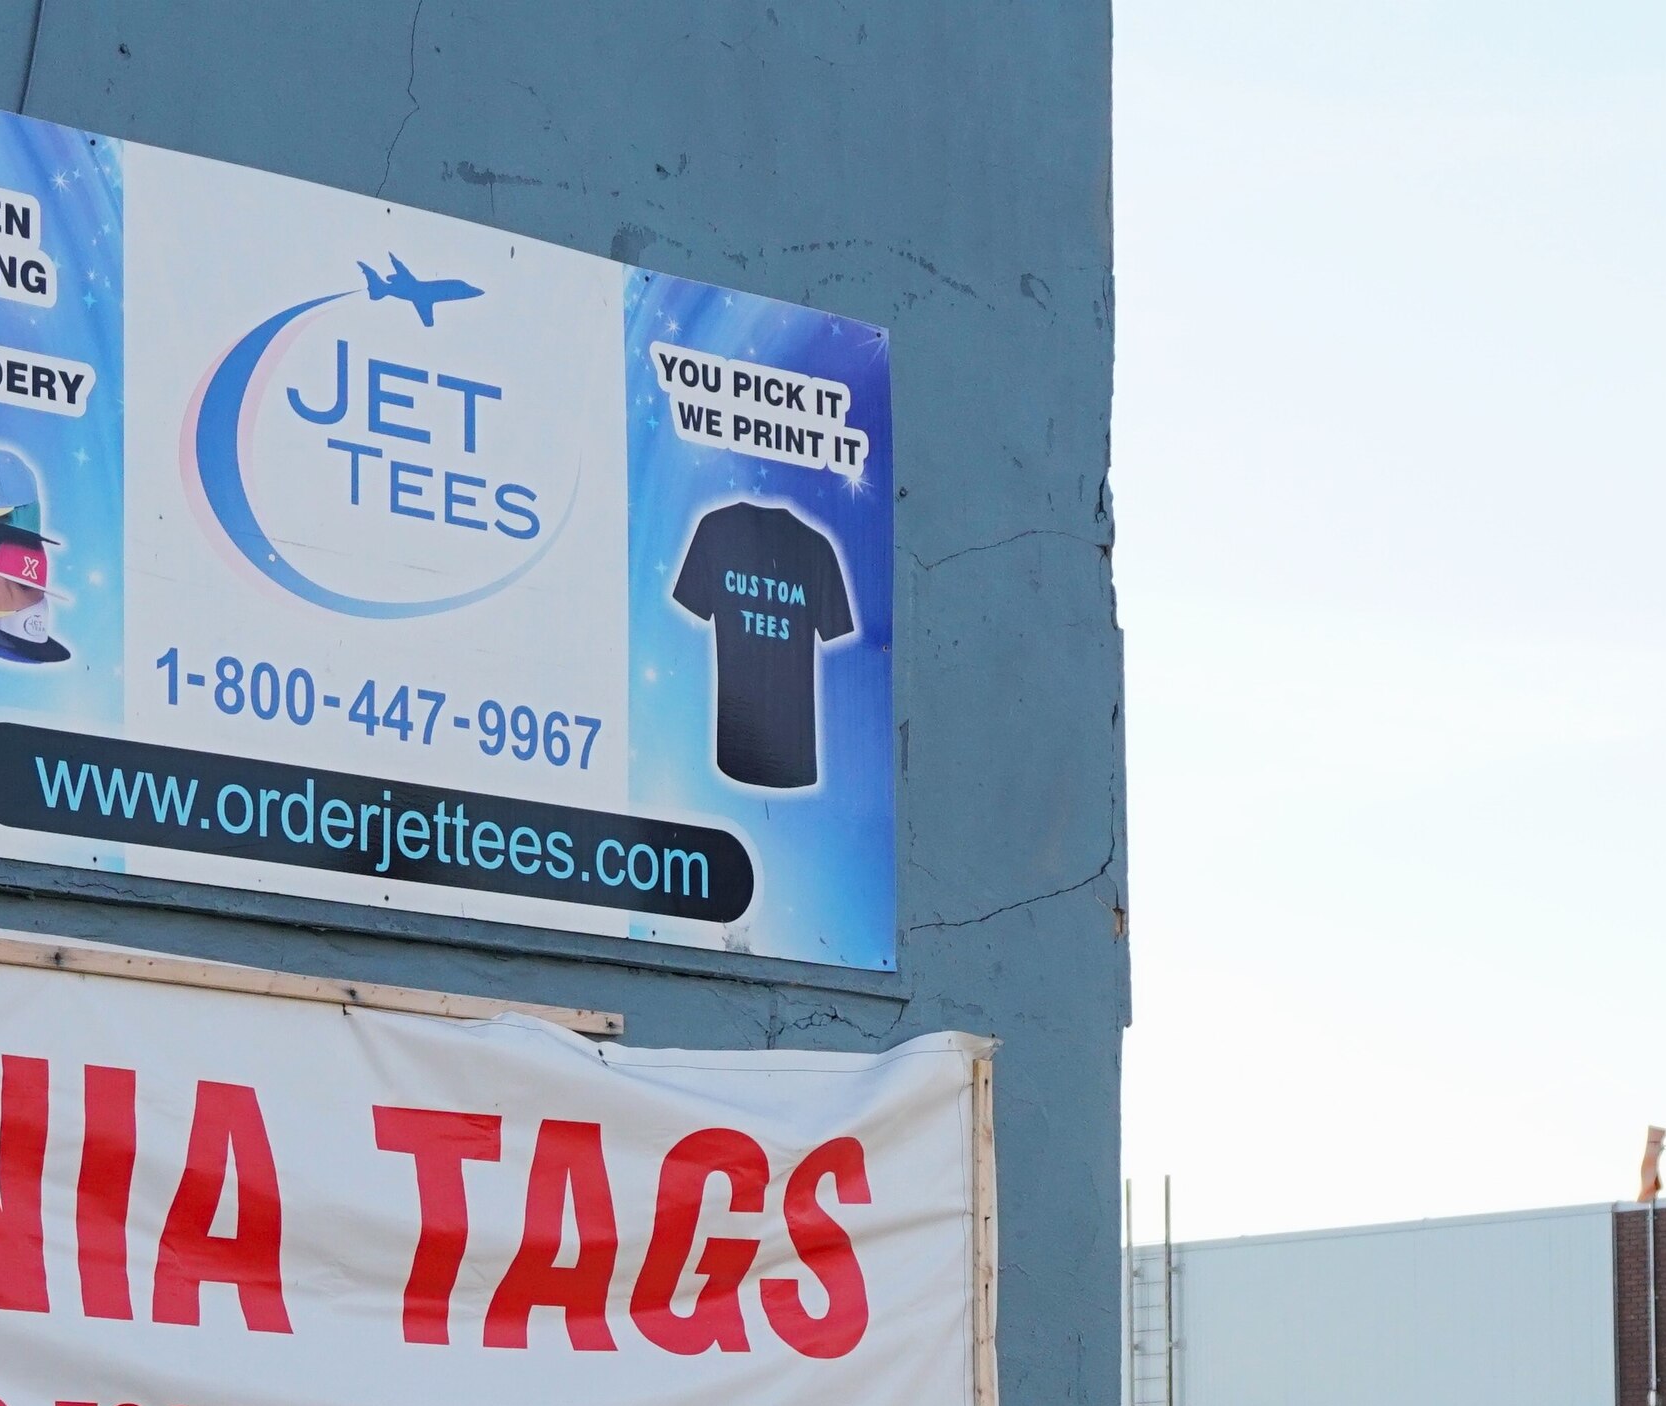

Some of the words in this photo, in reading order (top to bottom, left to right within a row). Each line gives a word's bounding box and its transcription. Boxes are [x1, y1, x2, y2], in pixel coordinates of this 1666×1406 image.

[286, 339, 502, 453] JET
[658, 353, 722, 393] YOU
[733, 370, 806, 412] PICK
[816, 388, 843, 419] IT
[678, 401, 723, 438] WE
[733, 414, 825, 459] PRINT
[835, 435, 861, 466] IT
[327, 437, 541, 540] TEES
[21, 556, 39, 580] X
[724, 569, 807, 607] CUSTOM
[740, 609, 790, 640] TEES
[156, 647, 602, 770] 1-800-447-9967
[35, 755, 709, 899] www.orderjettees.com
[372, 1105, 873, 1360] TAGS
